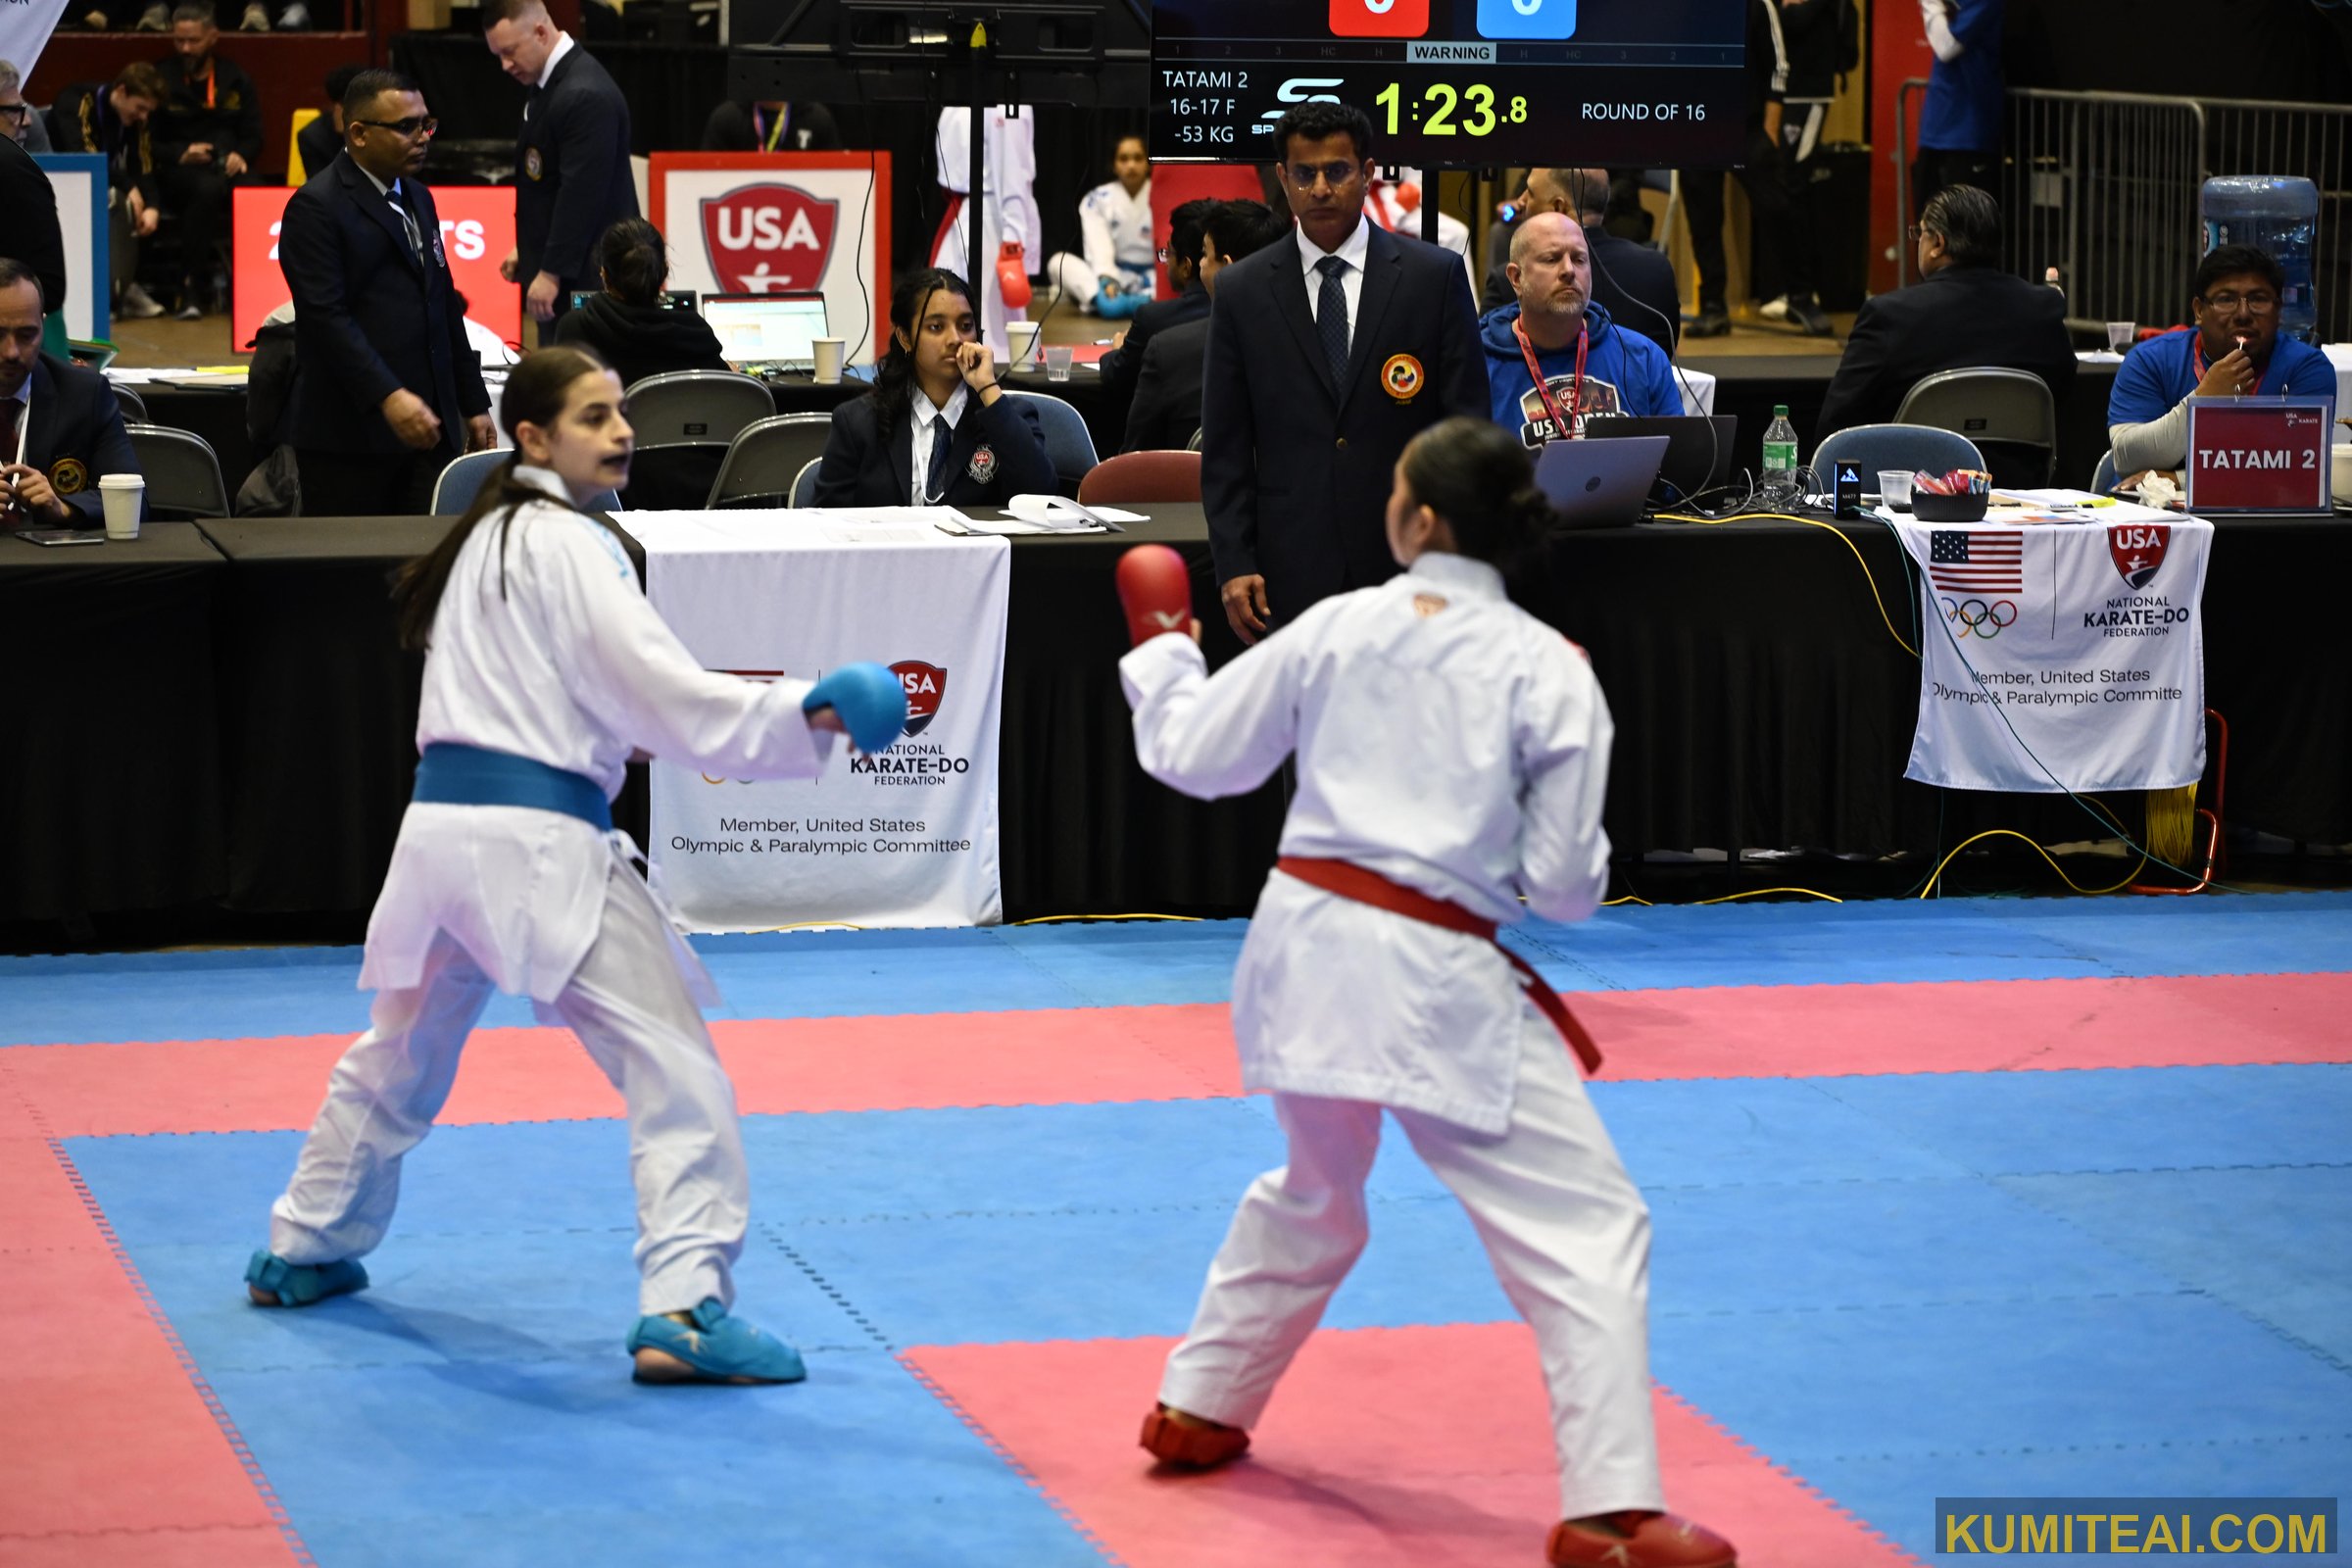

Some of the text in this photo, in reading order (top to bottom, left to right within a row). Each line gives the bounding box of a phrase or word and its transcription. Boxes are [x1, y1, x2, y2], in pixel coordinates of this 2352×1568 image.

[1414, 46, 1491, 60] WARNING
[1162, 71, 1249, 88] TATAMI 2
[1170, 98, 1236, 116] 16-17 F
[1582, 103, 1706, 121] ROUND OF 16
[1174, 125, 1235, 143] -53 KG
[717, 206, 821, 251] USA
[2198, 449, 2316, 469] TATAMI 2
[2116, 528, 2162, 550] USA
[2106, 596, 2170, 609] NATIONAL
[2083, 608, 2189, 627] KARATE-DO
[2103, 627, 2169, 638] FEDERATION
[2040, 670, 2094, 684] United
[2099, 668, 2150, 683] States
[1992, 691, 2002, 705] &
[2007, 690, 2098, 706] Paralympic
[851, 758, 969, 774] KARATE-DO
[874, 775, 946, 785] FEDERATION
[720, 817, 926, 834] Member, United States
[671, 836, 971, 856] Olympic & Paralympic Committee
